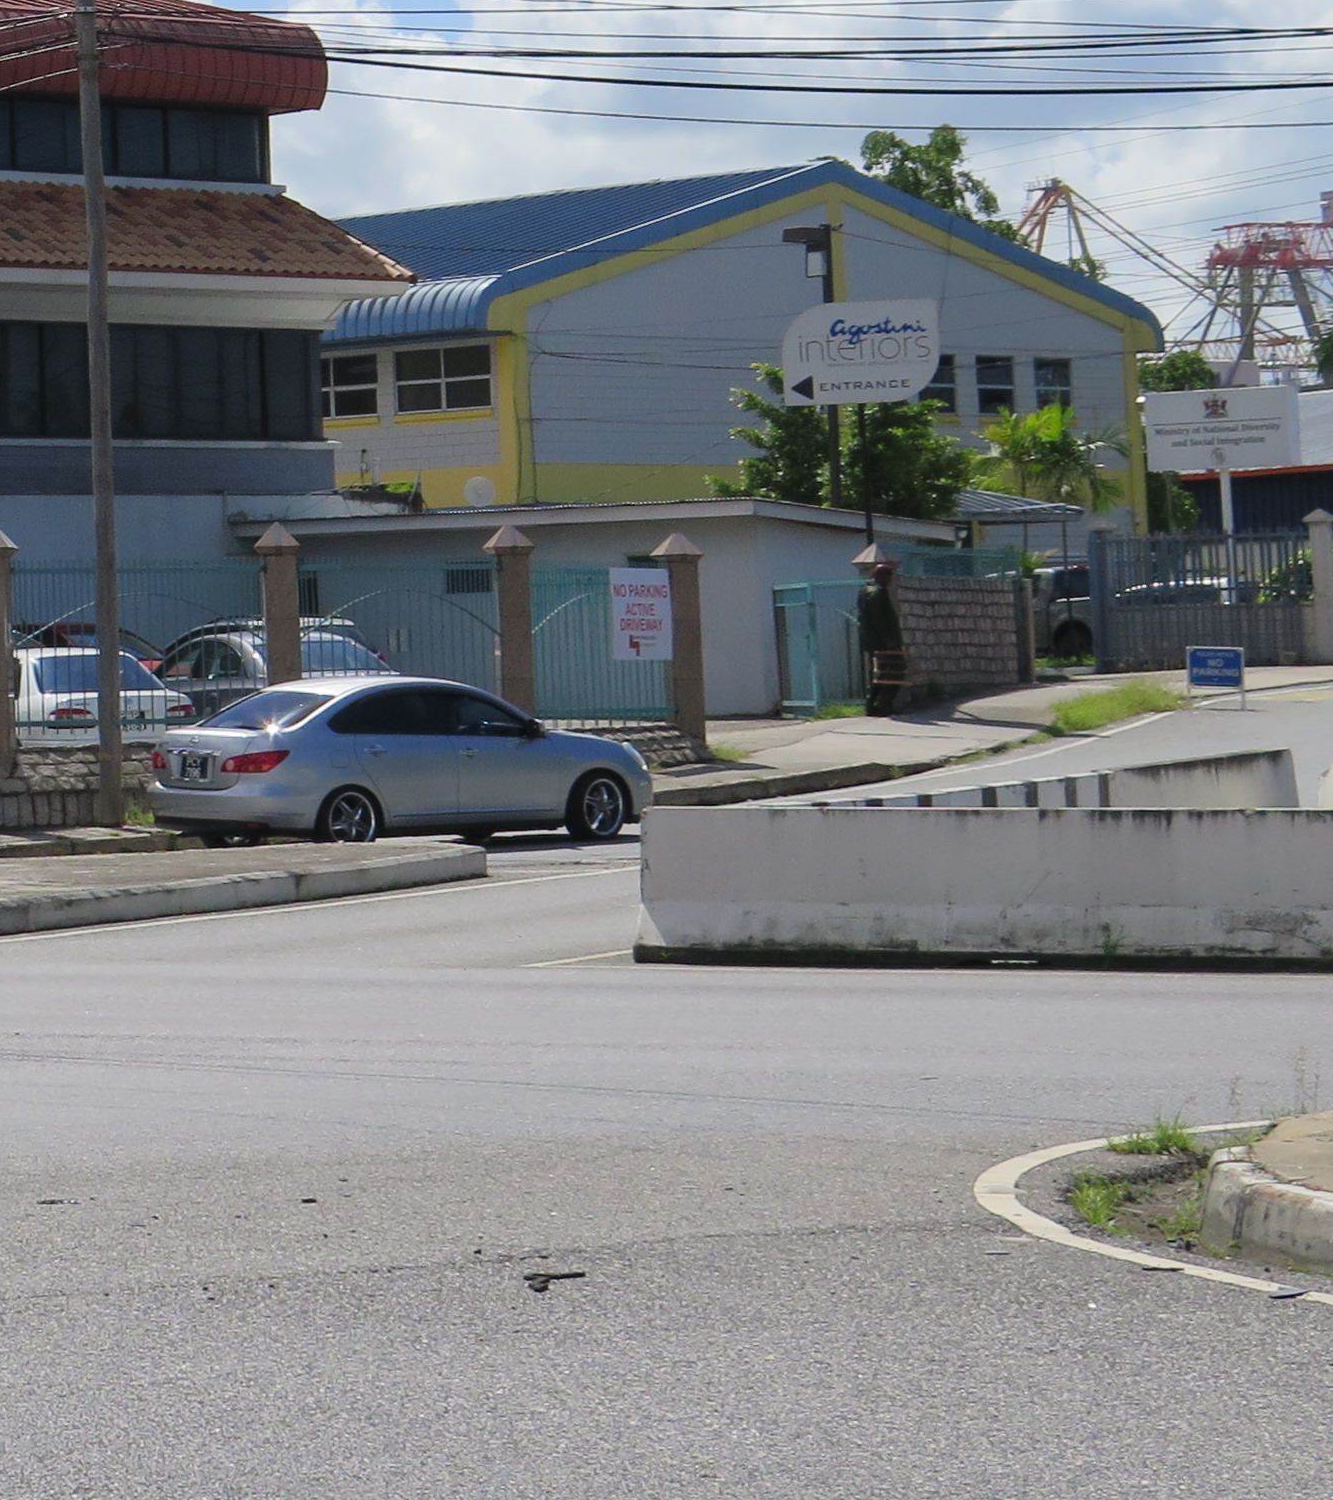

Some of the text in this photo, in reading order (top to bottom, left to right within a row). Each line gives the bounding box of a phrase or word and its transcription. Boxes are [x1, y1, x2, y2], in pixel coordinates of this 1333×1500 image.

[798, 334, 932, 363] interiors
[819, 379, 911, 392] ENTRANCE
[613, 584, 668, 597] NO PARKING
[625, 603, 655, 616] ACTIVE
[620, 618, 663, 631] DRIVEWAY
[1207, 659, 1224, 668] NO
